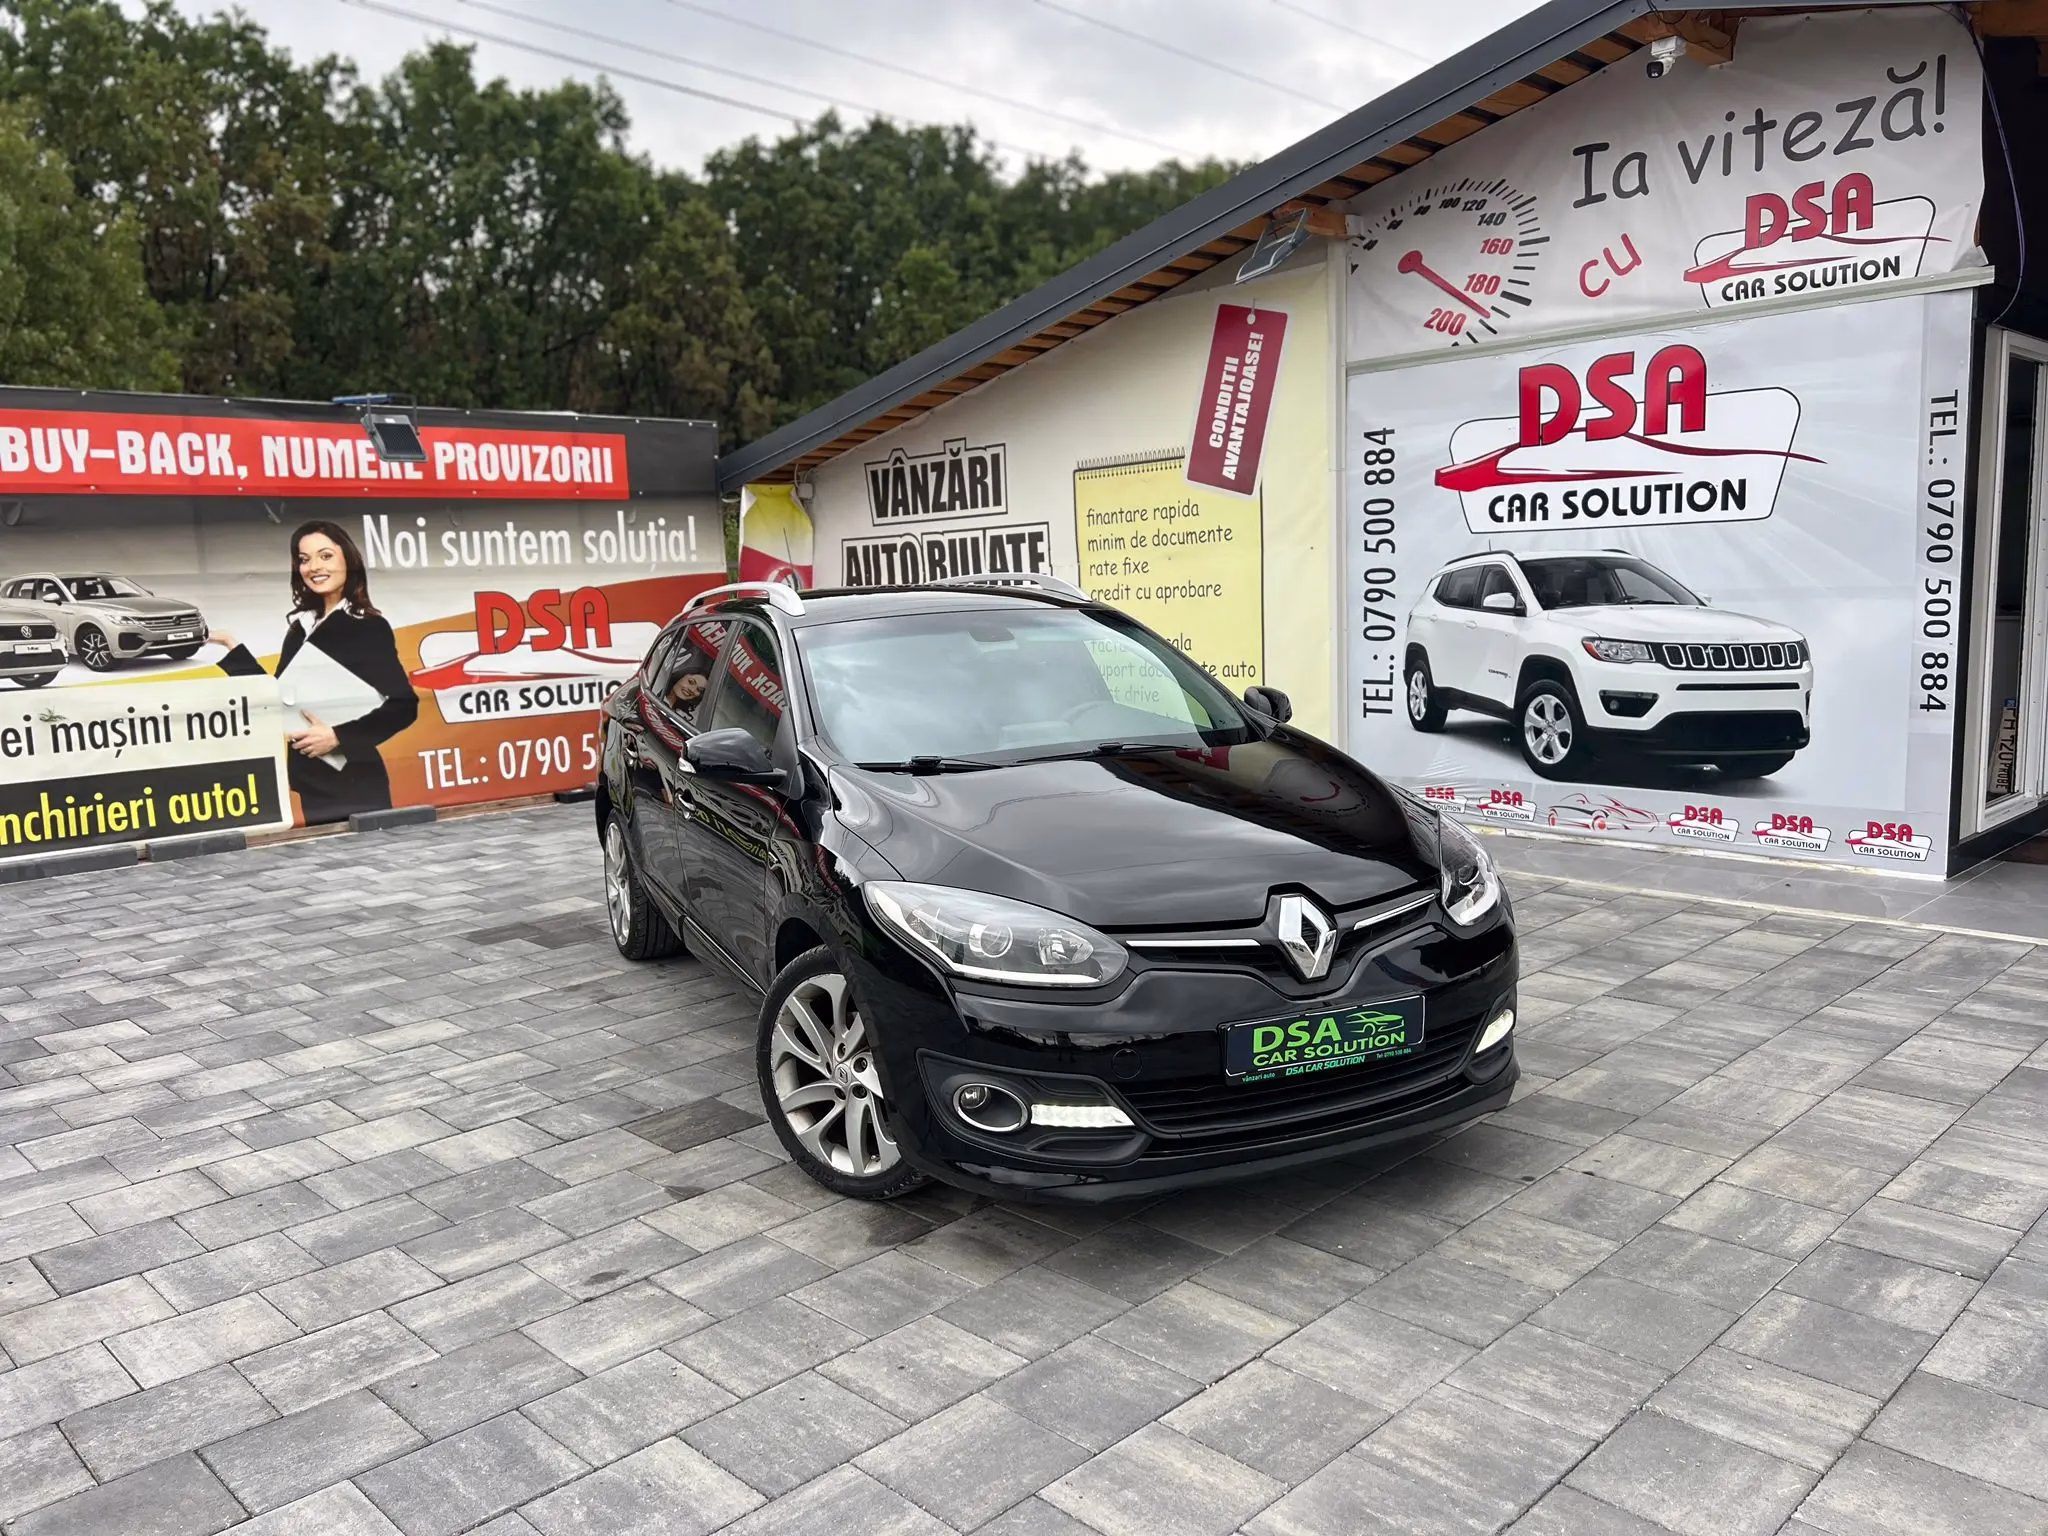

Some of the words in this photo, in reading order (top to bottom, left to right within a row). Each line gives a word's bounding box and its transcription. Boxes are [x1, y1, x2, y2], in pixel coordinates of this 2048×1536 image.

[1572, 141, 1650, 209] Ia
[1677, 54, 1947, 185] viteză!
[1439, 197, 1462, 209] 100
[1461, 199, 1488, 212] 120
[1477, 212, 1507, 226] 140
[1745, 172, 1874, 250] DSA
[1479, 238, 1514, 255] 160
[1579, 232, 1642, 298] cu
[1721, 277, 1766, 302] CAR
[1774, 255, 1900, 295] SOLUTION
[1463, 273, 1501, 296] 180
[1423, 307, 1467, 336] 200
[1209, 356, 1239, 449] CONDITII
[1221, 331, 1264, 481] AVANTAJOASE!
[1519, 343, 1707, 447] DSA
[0, 426, 248, 480] BUY-BACK,
[433, 440, 614, 484] PROVIZORII
[1363, 427, 1396, 486] 884
[870, 446, 1002, 519] VÂNZĂRI
[1488, 490, 1549, 523] CAR
[1562, 478, 1747, 520] SOLUTION
[1086, 507, 1148, 527] finantare
[1153, 498, 1200, 524] rapida
[1363, 498, 1396, 554] 500
[1926, 479, 1956, 564] 0790
[362, 513, 429, 569] Noi
[440, 521, 572, 567] suntem
[583, 510, 698, 572] soluția!
[1088, 534, 1126, 552] minim
[1130, 530, 1147, 548] de
[1152, 525, 1233, 547] documente
[1089, 560, 1118, 576] rate
[1122, 557, 1150, 576] fixe
[1090, 583, 1131, 601] credit
[1136, 586, 1151, 600] cu
[1155, 579, 1222, 604] aprobare
[1363, 567, 1396, 642] 0790
[1922, 578, 1951, 639] 500
[474, 586, 613, 655] DSA
[1222, 661, 1256, 678] auto
[1919, 652, 1949, 712] 884
[459, 688, 510, 714] CAR
[50, 703, 172, 758] mașini
[186, 695, 251, 741] noi!
[498, 735, 571, 780] 0790
[168, 773, 260, 825] auto!
[1490, 790, 1523, 806] DSA
[1499, 811, 1530, 820] SOLUTION
[1684, 805, 1723, 825] DSA
[1677, 828, 1691, 836] CAR
[1693, 829, 1730, 840] SOLUTION
[1772, 813, 1813, 833] DSA
[1867, 821, 1913, 842] DSA
[1764, 837, 1779, 845] CAR
[1780, 838, 1821, 850] SOLUTION
[1858, 845, 1875, 854] CAR
[1877, 846, 1921, 859] SOLUTION
[1252, 1017, 1342, 1054] DSA
[1253, 1048, 1298, 1067] CAR
[1303, 1031, 1405, 1059] SOLUTION
[1285, 1066, 1305, 1077] DSA
[1305, 1062, 1323, 1073] CAR
[1323, 1055, 1366, 1071] SOLUTION
